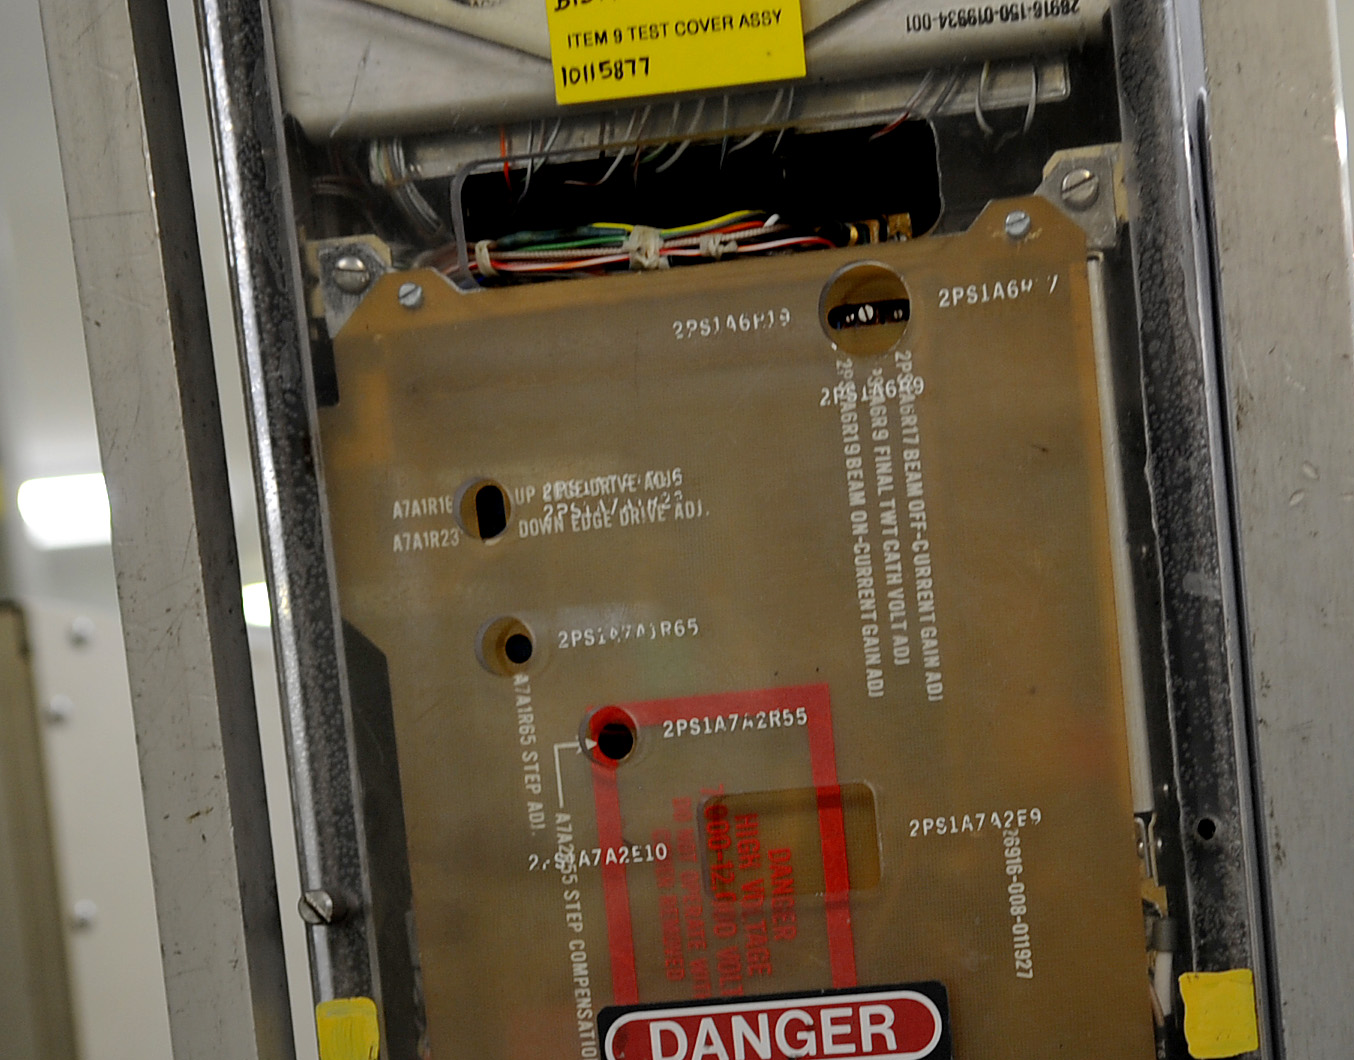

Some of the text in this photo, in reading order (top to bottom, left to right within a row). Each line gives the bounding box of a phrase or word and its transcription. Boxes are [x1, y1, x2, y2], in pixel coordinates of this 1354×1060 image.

[567, 9, 783, 49] ITEM 9 TEST COVER ASSY
[561, 57, 650, 87] 10115877
[845, 456, 866, 507] BEAM
[873, 445, 895, 497] FINAL
[903, 449, 924, 498] BEAM
[515, 486, 536, 506] UP
[879, 498, 899, 536] TWT
[392, 529, 460, 552] A7A1R23
[519, 516, 565, 538] DOWN
[850, 510, 878, 622] ON-CURRENT
[883, 538, 903, 585] CATH
[908, 499, 936, 623] OFF-CURRENT
[887, 587, 908, 631] VOLT
[861, 624, 882, 667] GAIN
[893, 635, 911, 666] ADJ
[920, 626, 941, 668] GAIN
[866, 668, 885, 698] ADJ
[925, 671, 944, 702] ADJ
[513, 673, 537, 746] A7A1R65
[522, 751, 542, 795] STEP
[908, 807, 1043, 838] 2PS1A7A2E9
[564, 889, 584, 934] STEP
[680, 869, 708, 950] OPERATE
[734, 813, 773, 977] HIGH VOLTAGE
[767, 848, 798, 941] DANGER
[1002, 826, 1034, 980] 26916-008-011927
